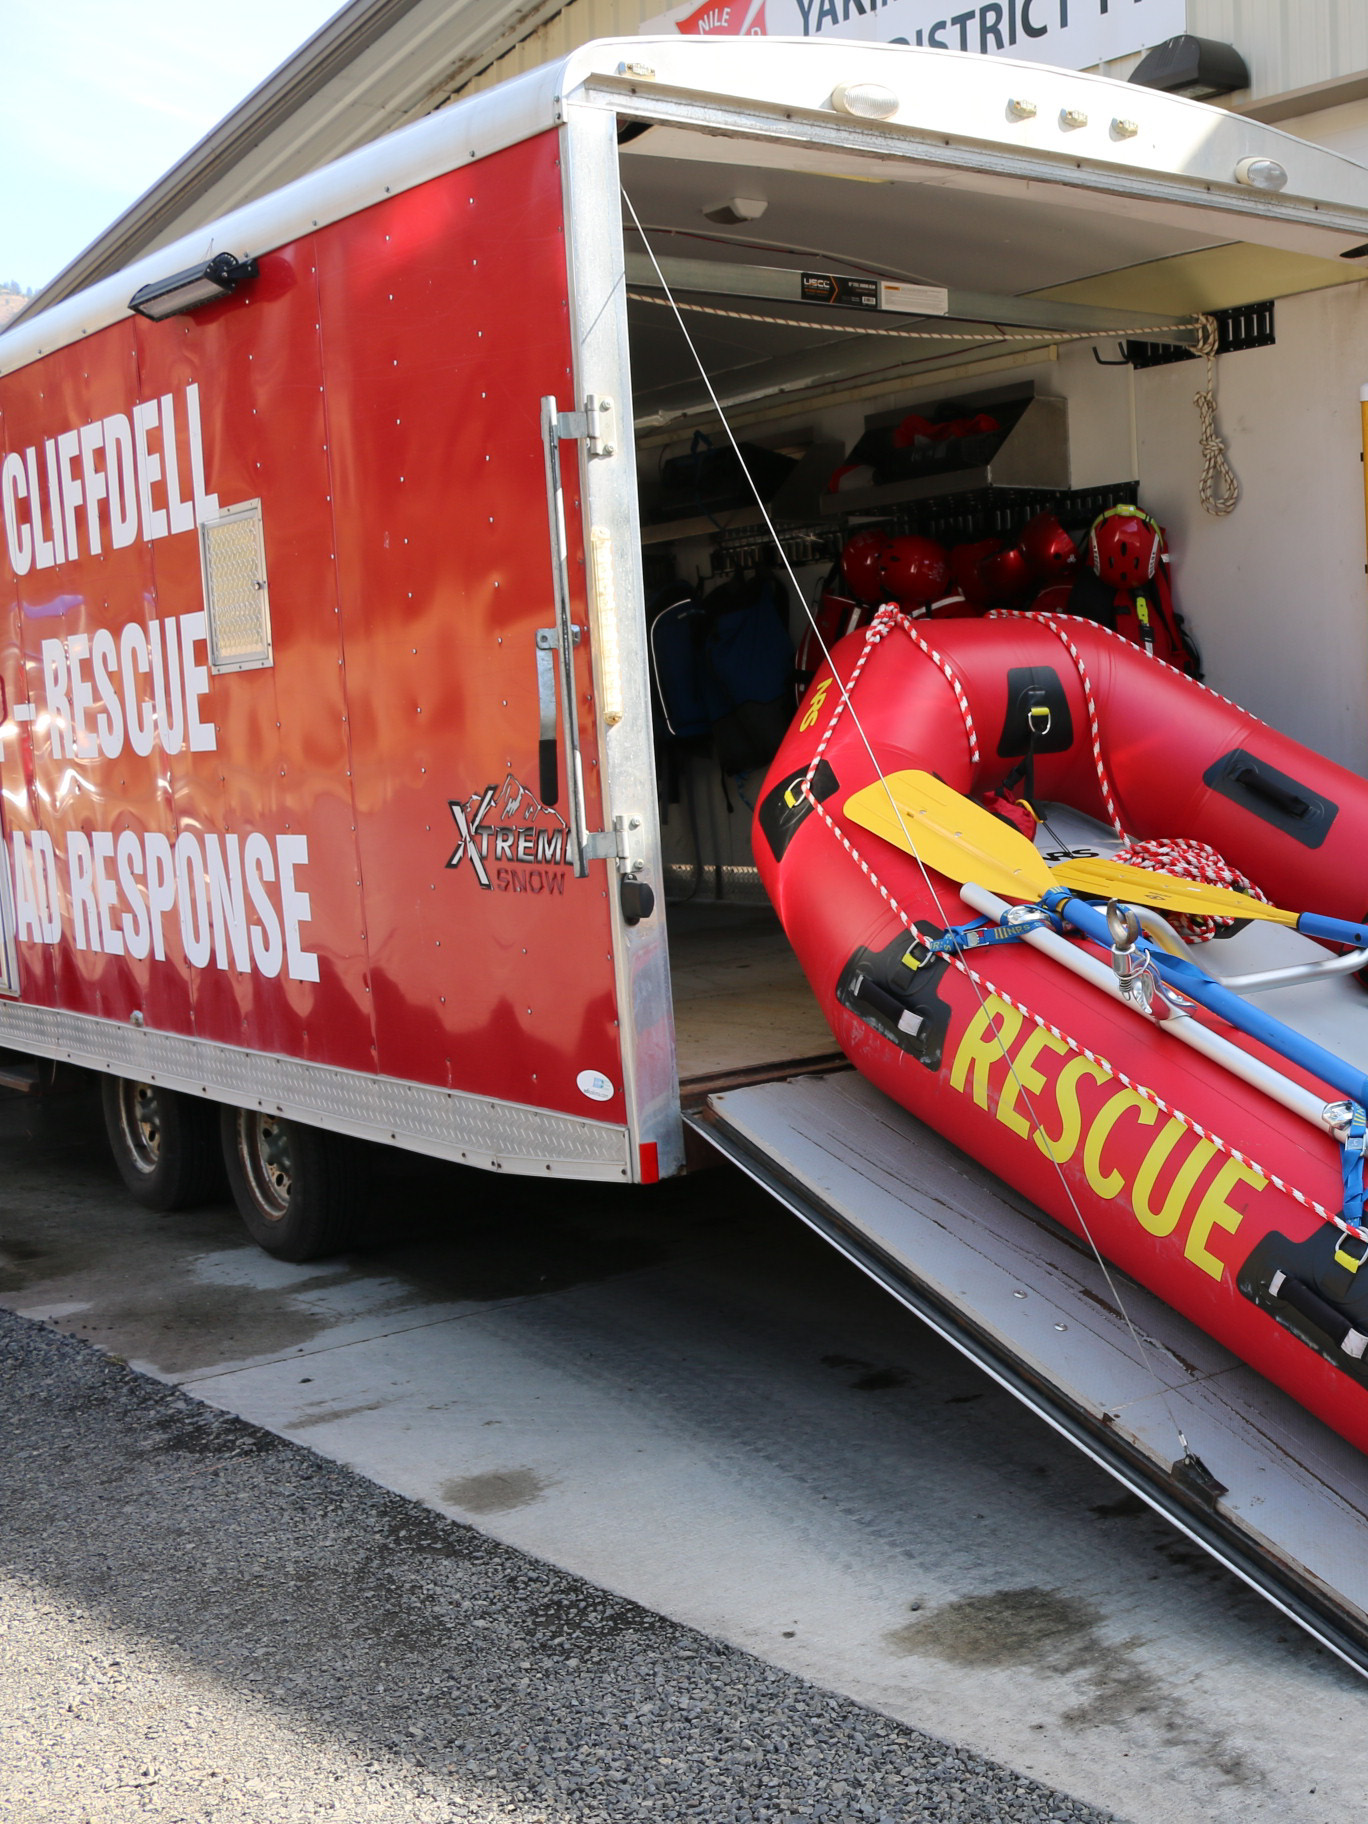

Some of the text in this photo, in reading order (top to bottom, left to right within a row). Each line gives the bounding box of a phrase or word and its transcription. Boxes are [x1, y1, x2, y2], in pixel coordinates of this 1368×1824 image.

[698, 7, 731, 34] NILE
[2, 383, 219, 575] CLIFFDELL
[41, 611, 217, 759] RESCUE
[799, 677, 833, 732] NRS
[496, 867, 565, 895] SNOW
[1043, 849, 1100, 861] RS
[66, 830, 321, 983] RESPONSE
[949, 993, 1270, 1283] RESCUE
